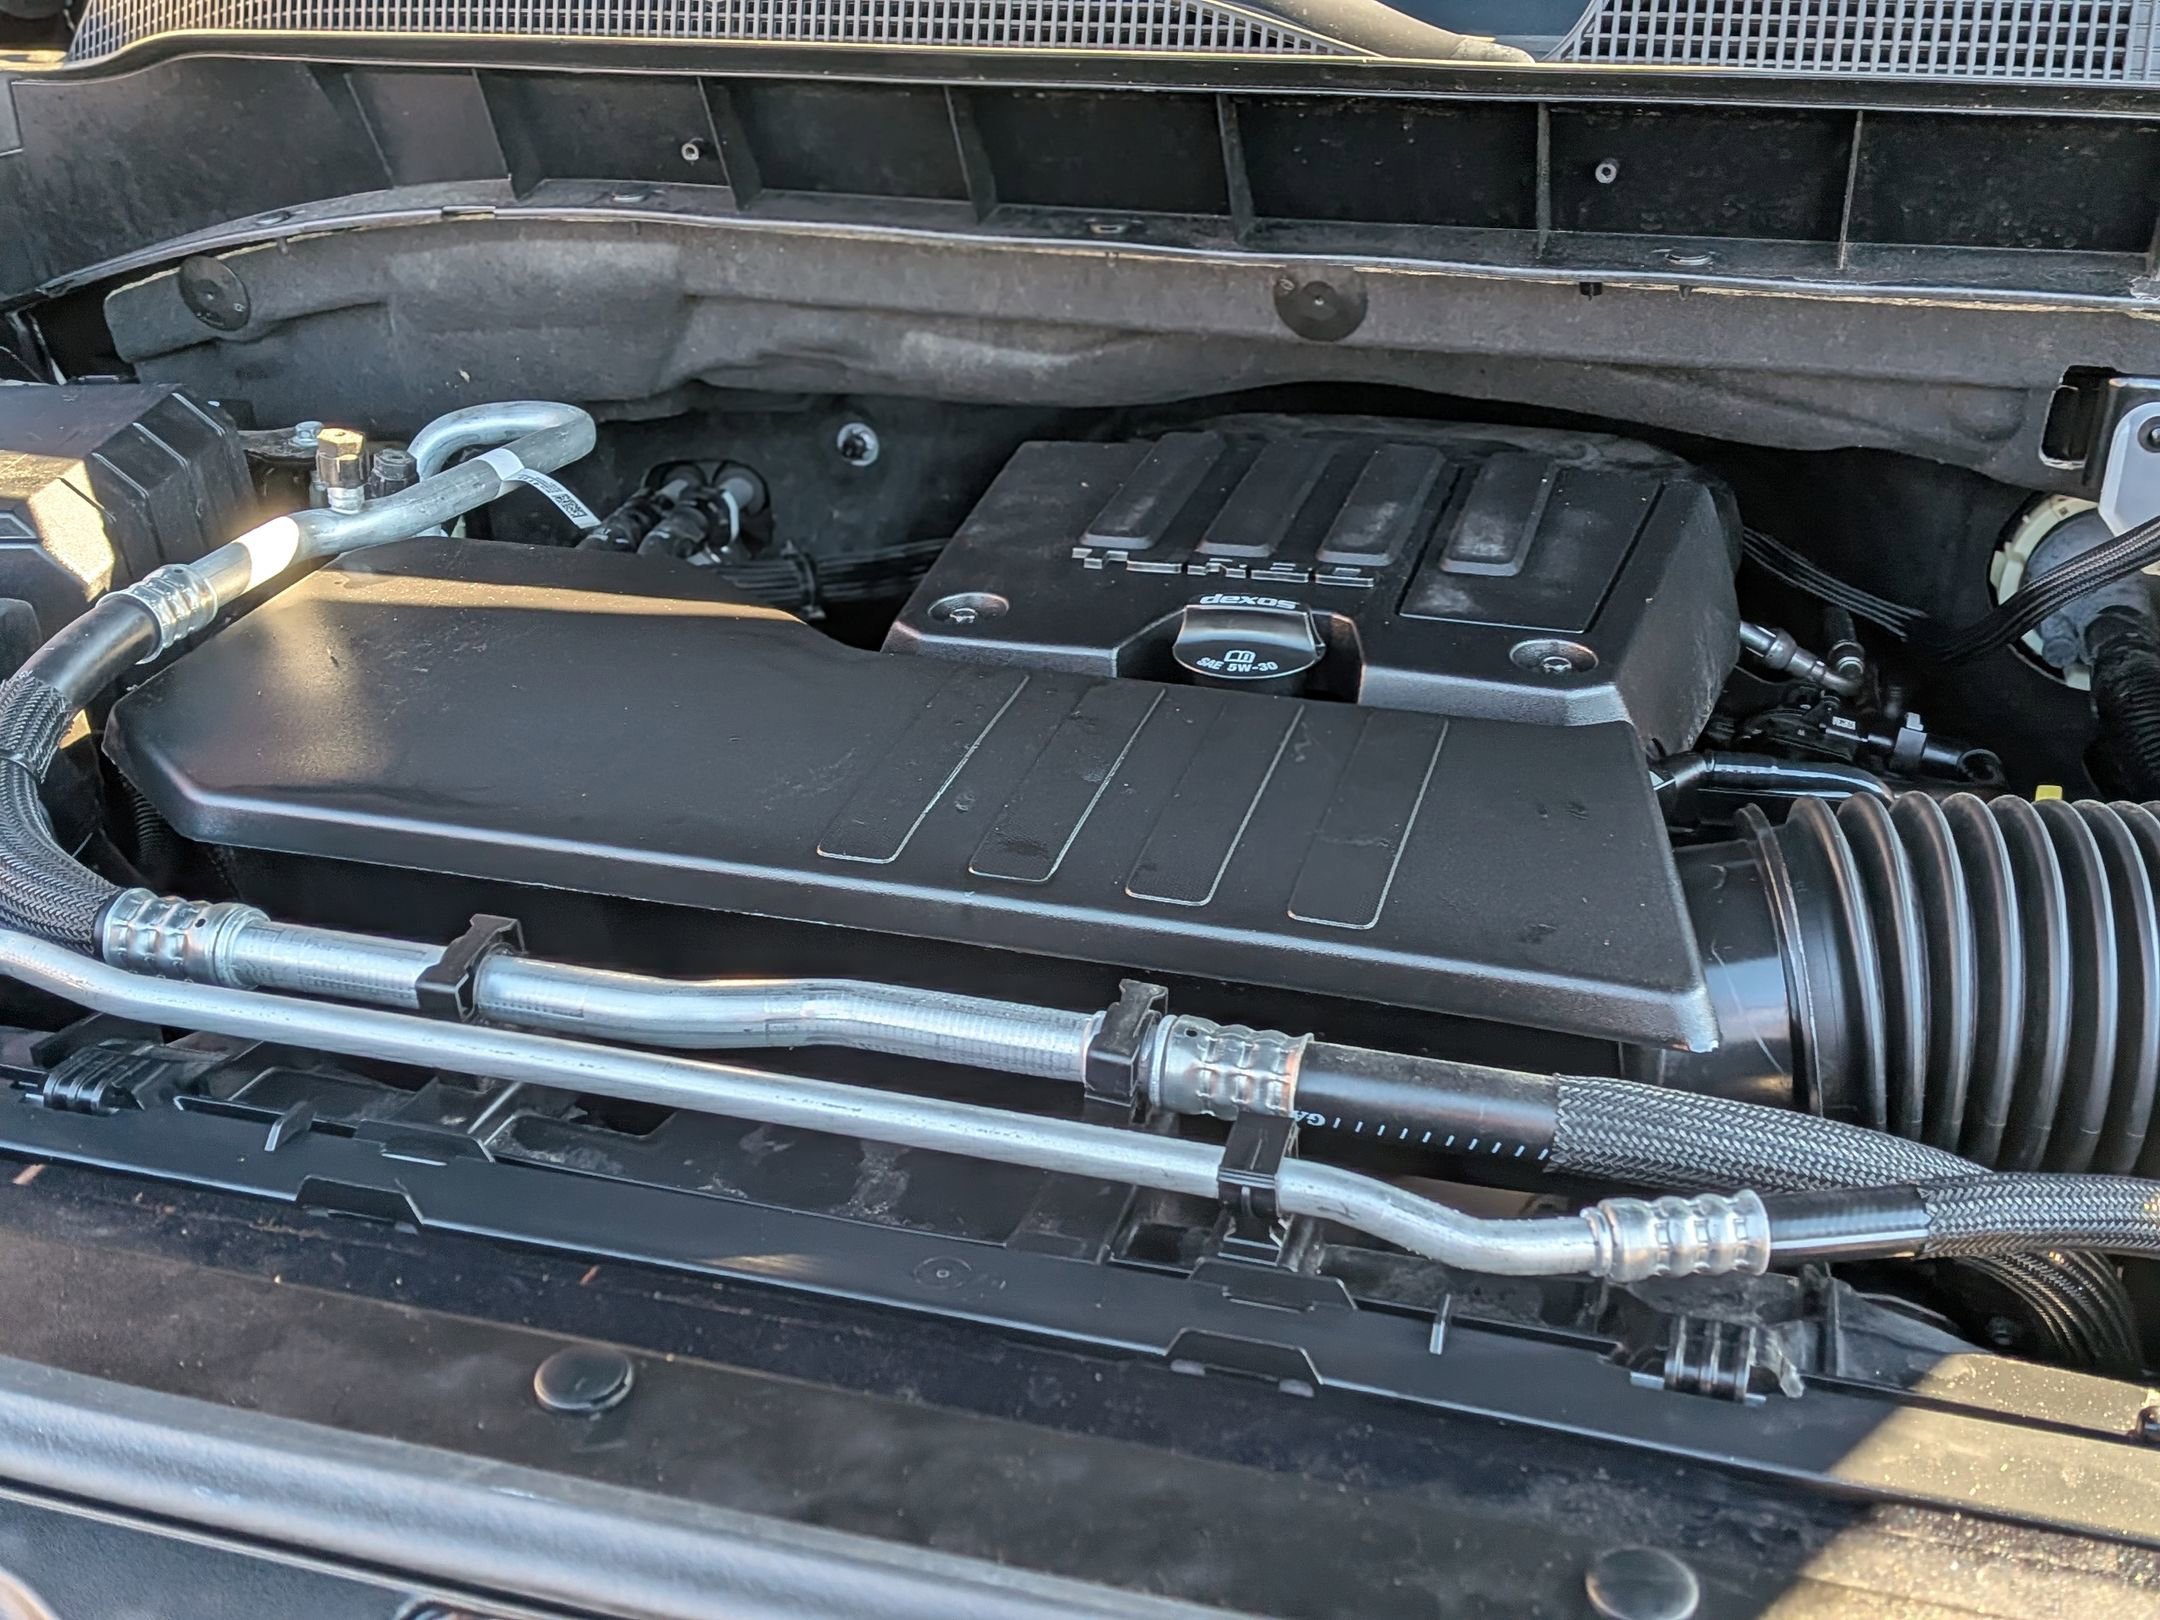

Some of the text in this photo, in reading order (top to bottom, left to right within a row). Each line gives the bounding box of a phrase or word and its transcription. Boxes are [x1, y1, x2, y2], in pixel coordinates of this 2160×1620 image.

[1071, 546, 1378, 589] TURBO
[1200, 593, 1297, 610] dexos
[1196, 657, 1279, 672] SAE 5W-30
